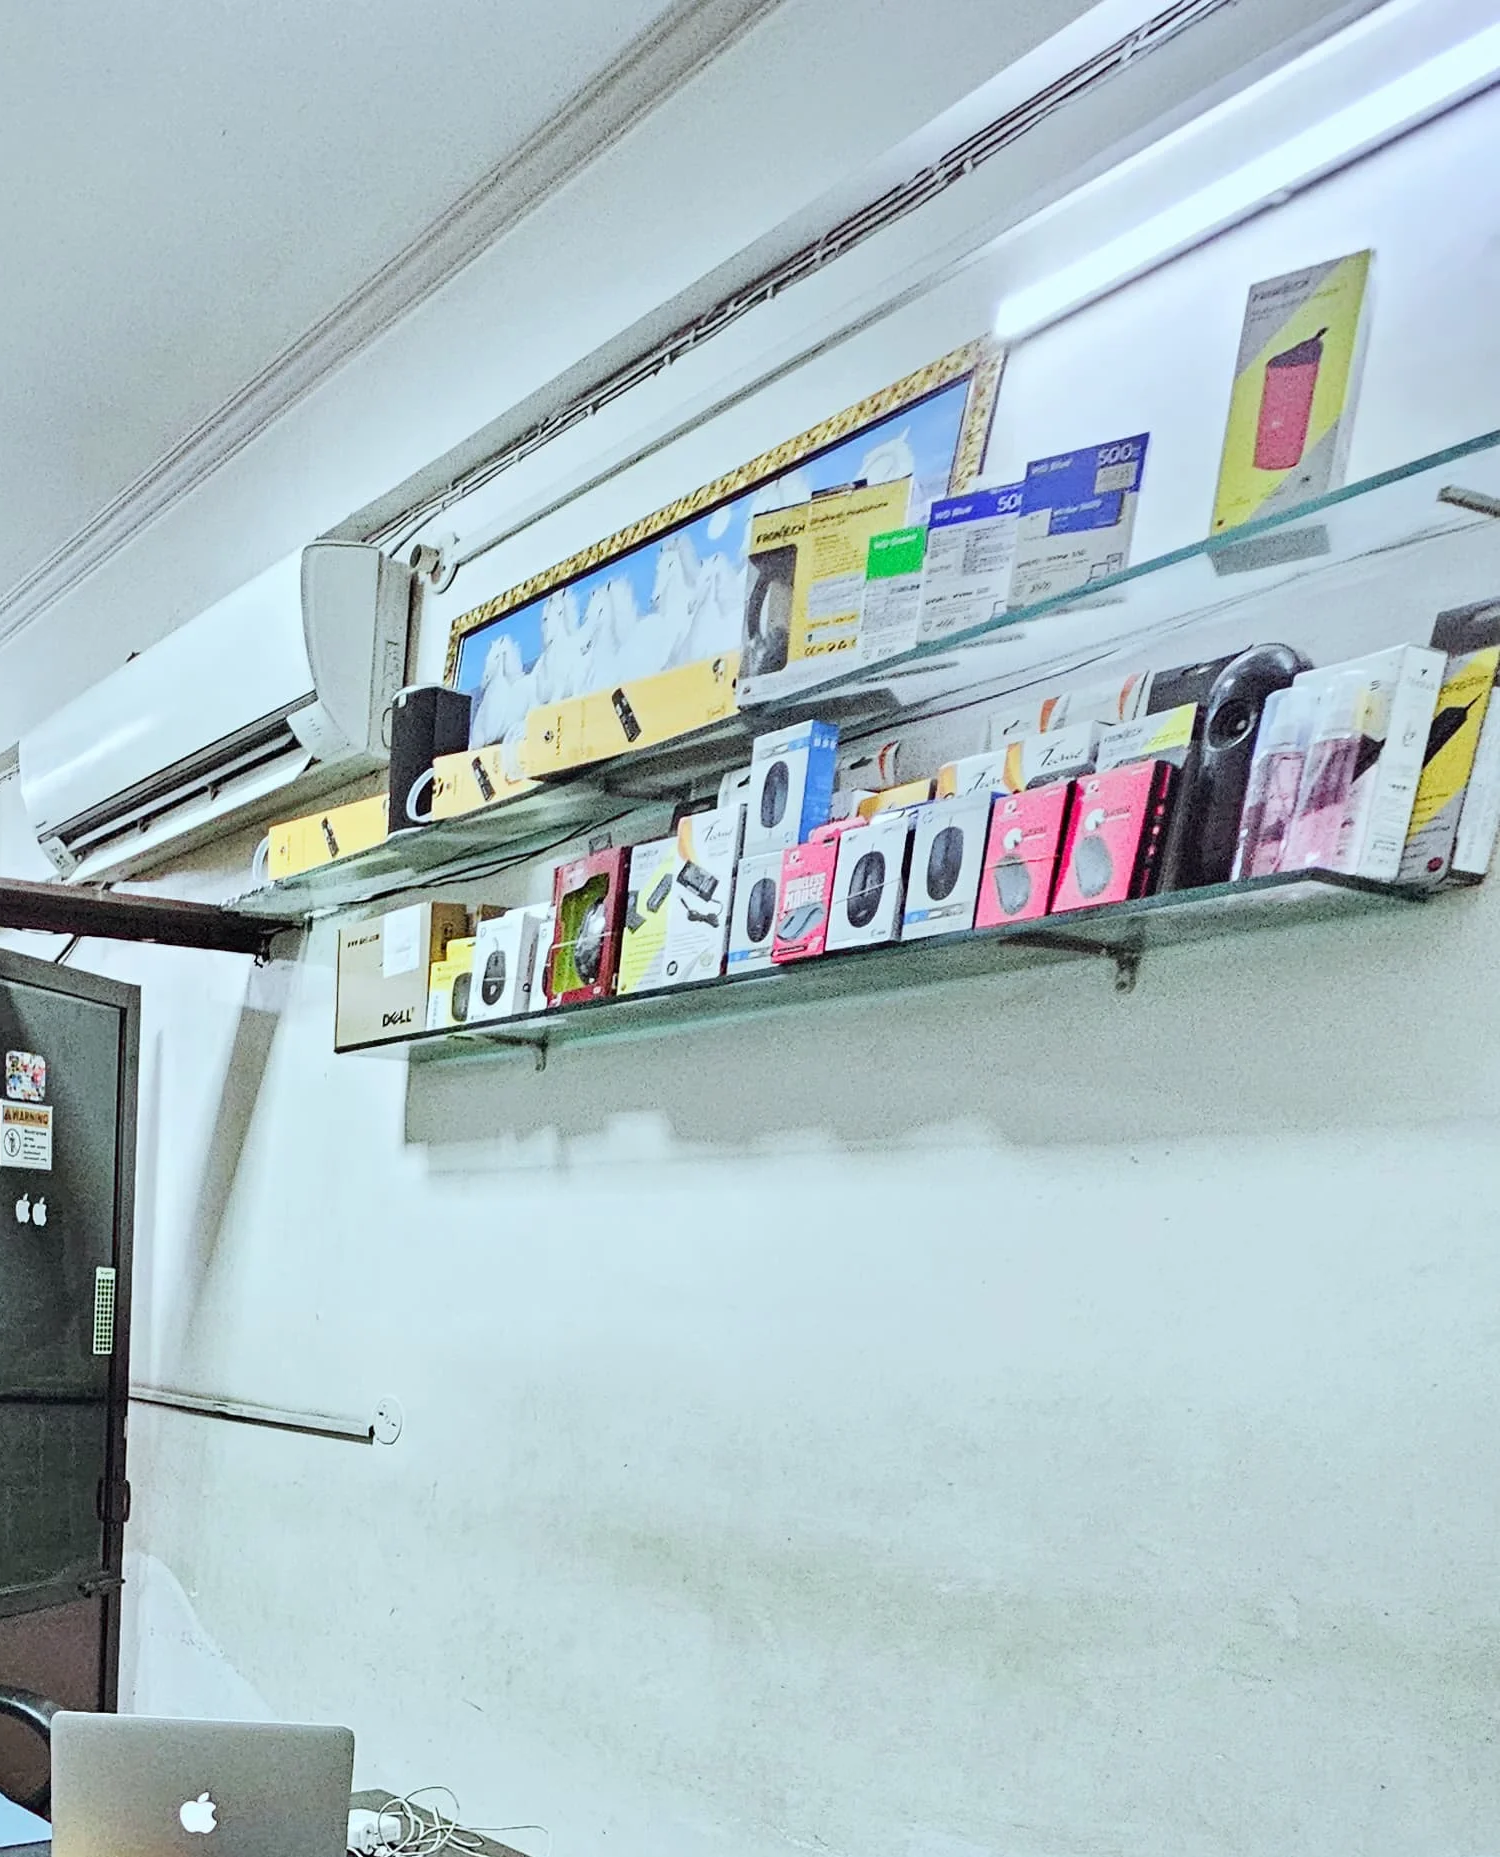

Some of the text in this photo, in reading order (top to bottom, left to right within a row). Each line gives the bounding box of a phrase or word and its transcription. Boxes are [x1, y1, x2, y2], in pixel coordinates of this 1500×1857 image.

[1098, 444, 1133, 465] 500
[382, 1009, 412, 1028] DELL
[12, 1109, 49, 1125] WARNING
